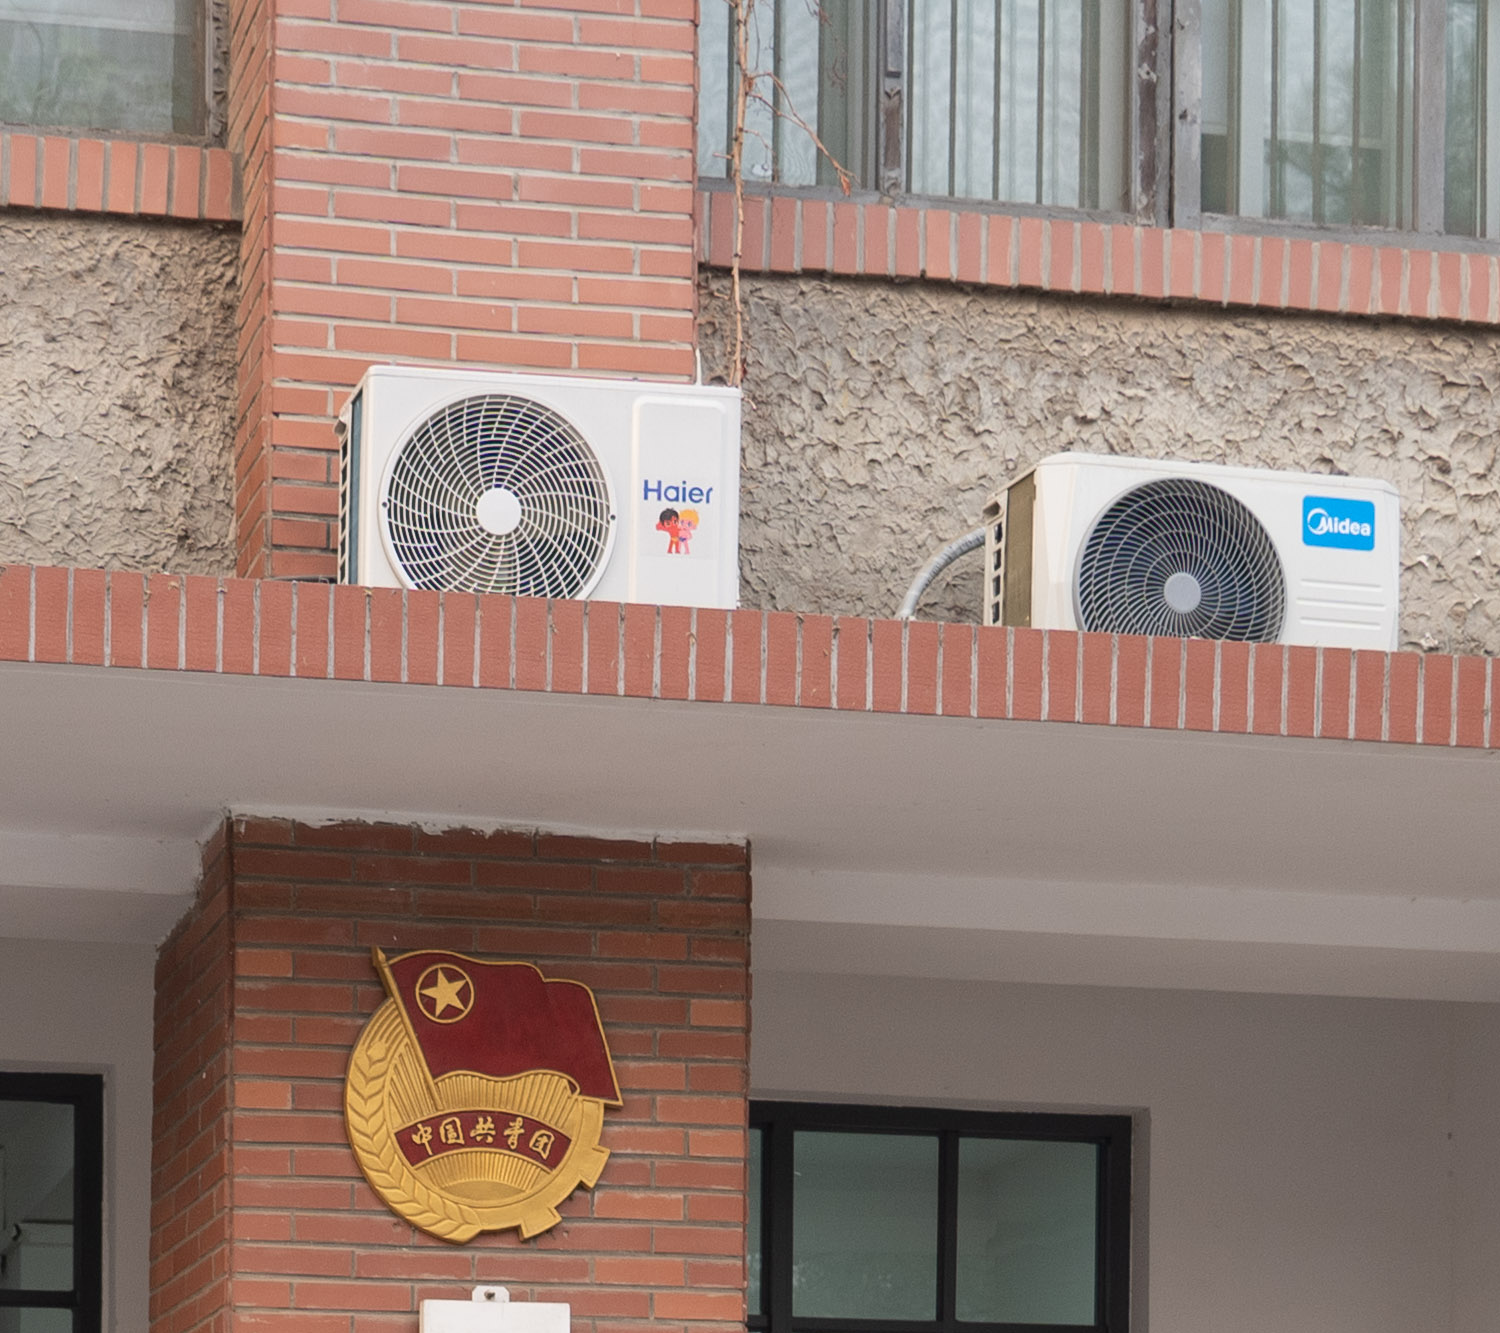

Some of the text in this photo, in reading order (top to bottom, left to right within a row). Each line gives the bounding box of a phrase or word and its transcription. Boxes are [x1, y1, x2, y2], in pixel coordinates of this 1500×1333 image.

[643, 479, 714, 504] Haier
[1307, 508, 1371, 537] Midea
[411, 1116, 555, 1160] 中国共青团
